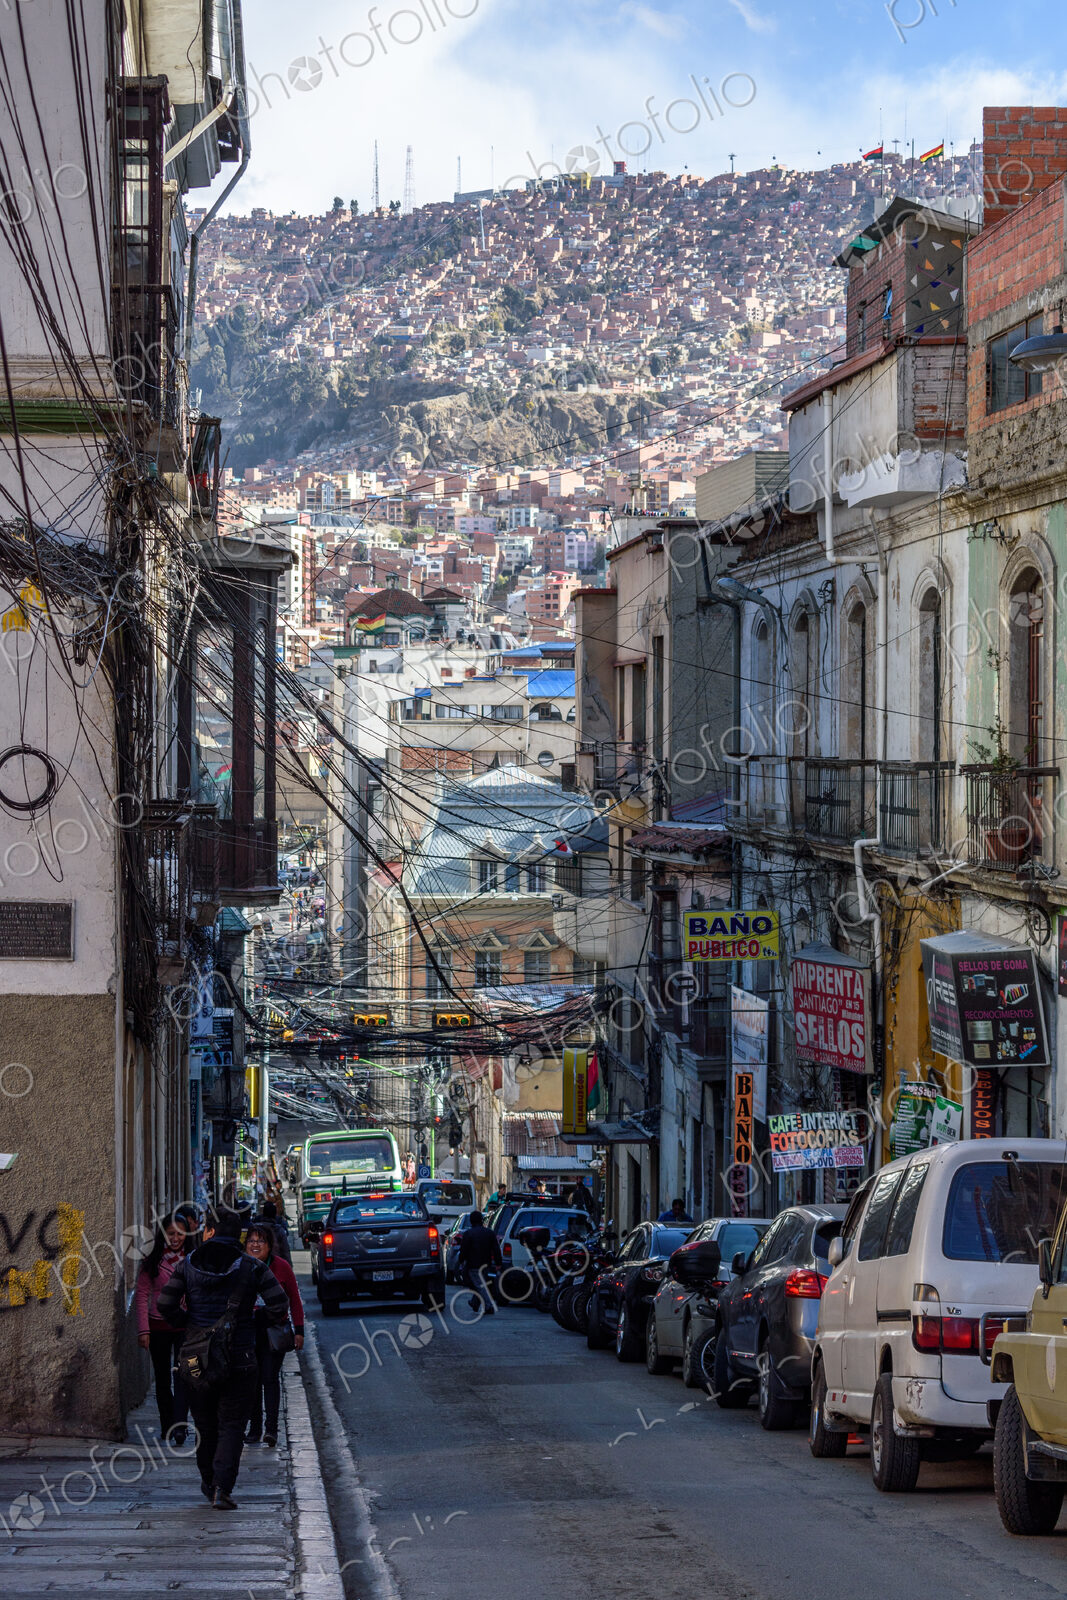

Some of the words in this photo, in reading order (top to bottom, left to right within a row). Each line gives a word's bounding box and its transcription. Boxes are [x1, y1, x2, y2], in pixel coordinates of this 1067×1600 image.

[688, 912, 773, 936] BAÑO
[687, 939, 760, 958] PUBLICO
[958, 961, 989, 971] SELLOS
[990, 961, 1002, 971] DE
[1003, 959, 1028, 970] GOMA
[792, 960, 864, 1000] IMPRENTA
[964, 1009, 1035, 1019] RECONOCIMIENTOS
[795, 1011, 865, 1059] SELLOS
[974, 1070, 992, 1128] SELLOS
[736, 1075, 752, 1163] BAÑO
[769, 1114, 798, 1133] CAFE
[800, 1112, 857, 1131] INTERNET
[770, 1129, 860, 1152] FOTOCOPIAS
[804, 1157, 834, 1168] CD-DVD
